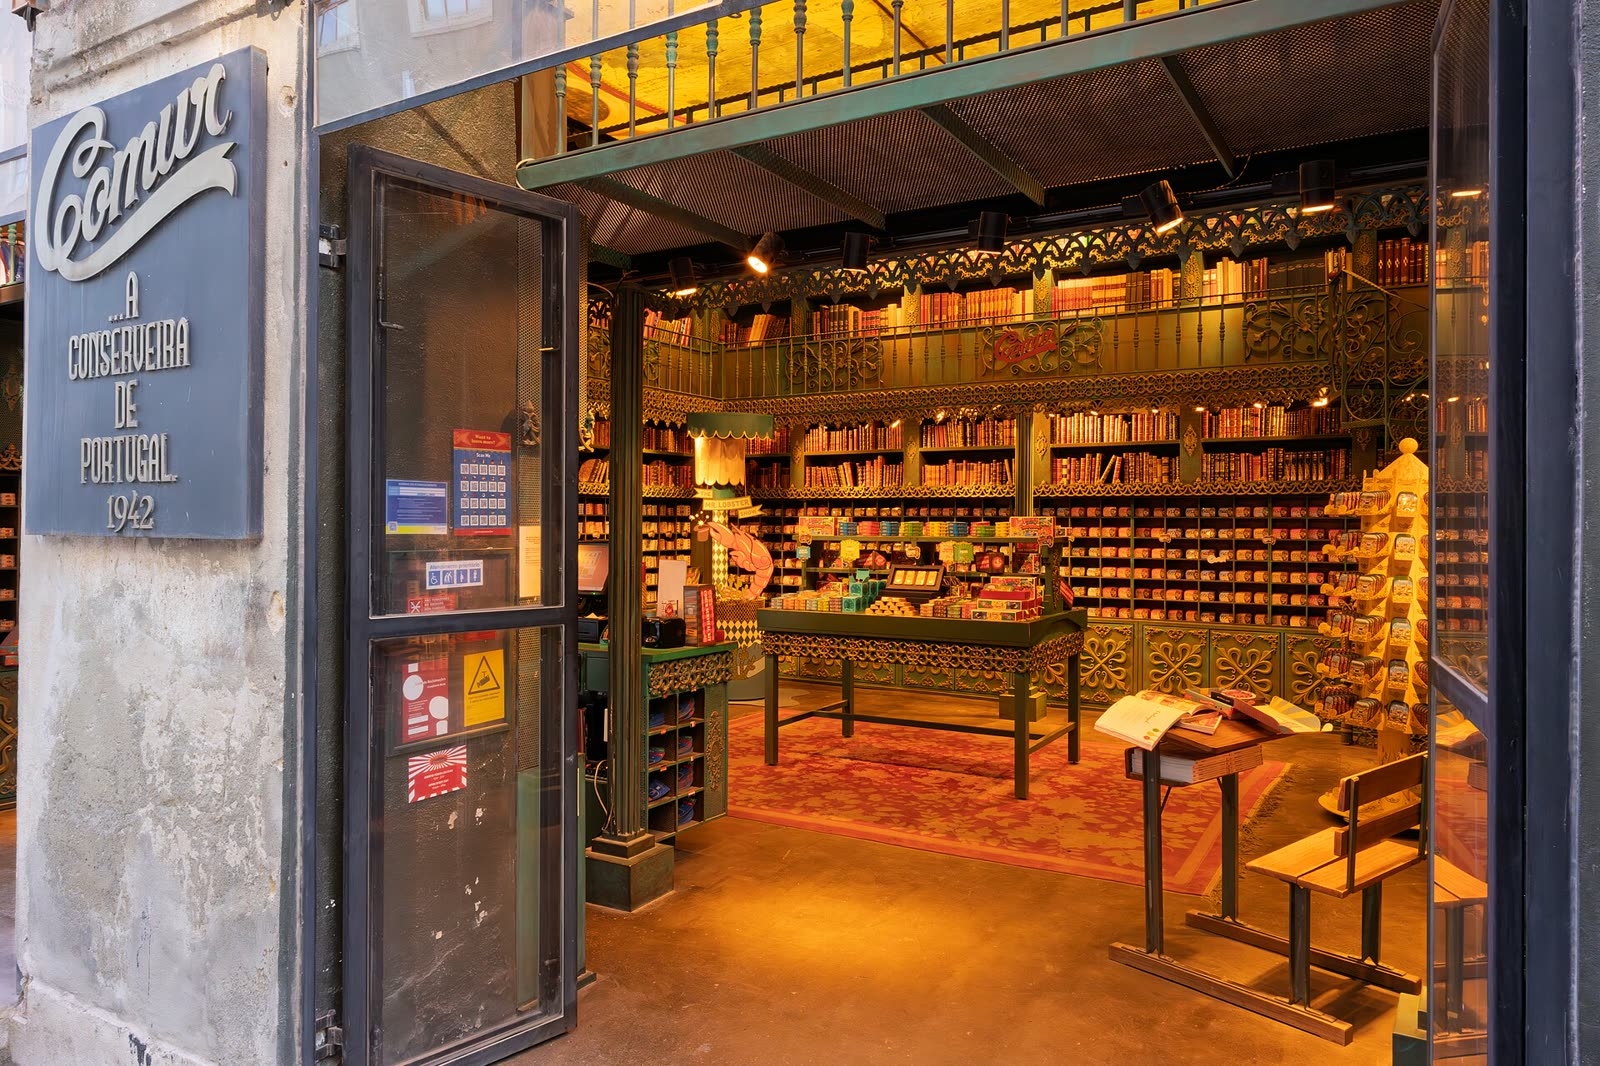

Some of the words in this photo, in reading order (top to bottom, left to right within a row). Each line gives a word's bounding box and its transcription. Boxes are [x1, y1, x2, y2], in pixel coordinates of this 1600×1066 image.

[34, 63, 234, 281] Comur
[68, 317, 190, 380] CONSERVEIRA
[114, 379, 139, 429] DE
[106, 490, 155, 533] 1942
[718, 499, 750, 508] LOBSTER
[740, 509, 758, 517] SHOW
